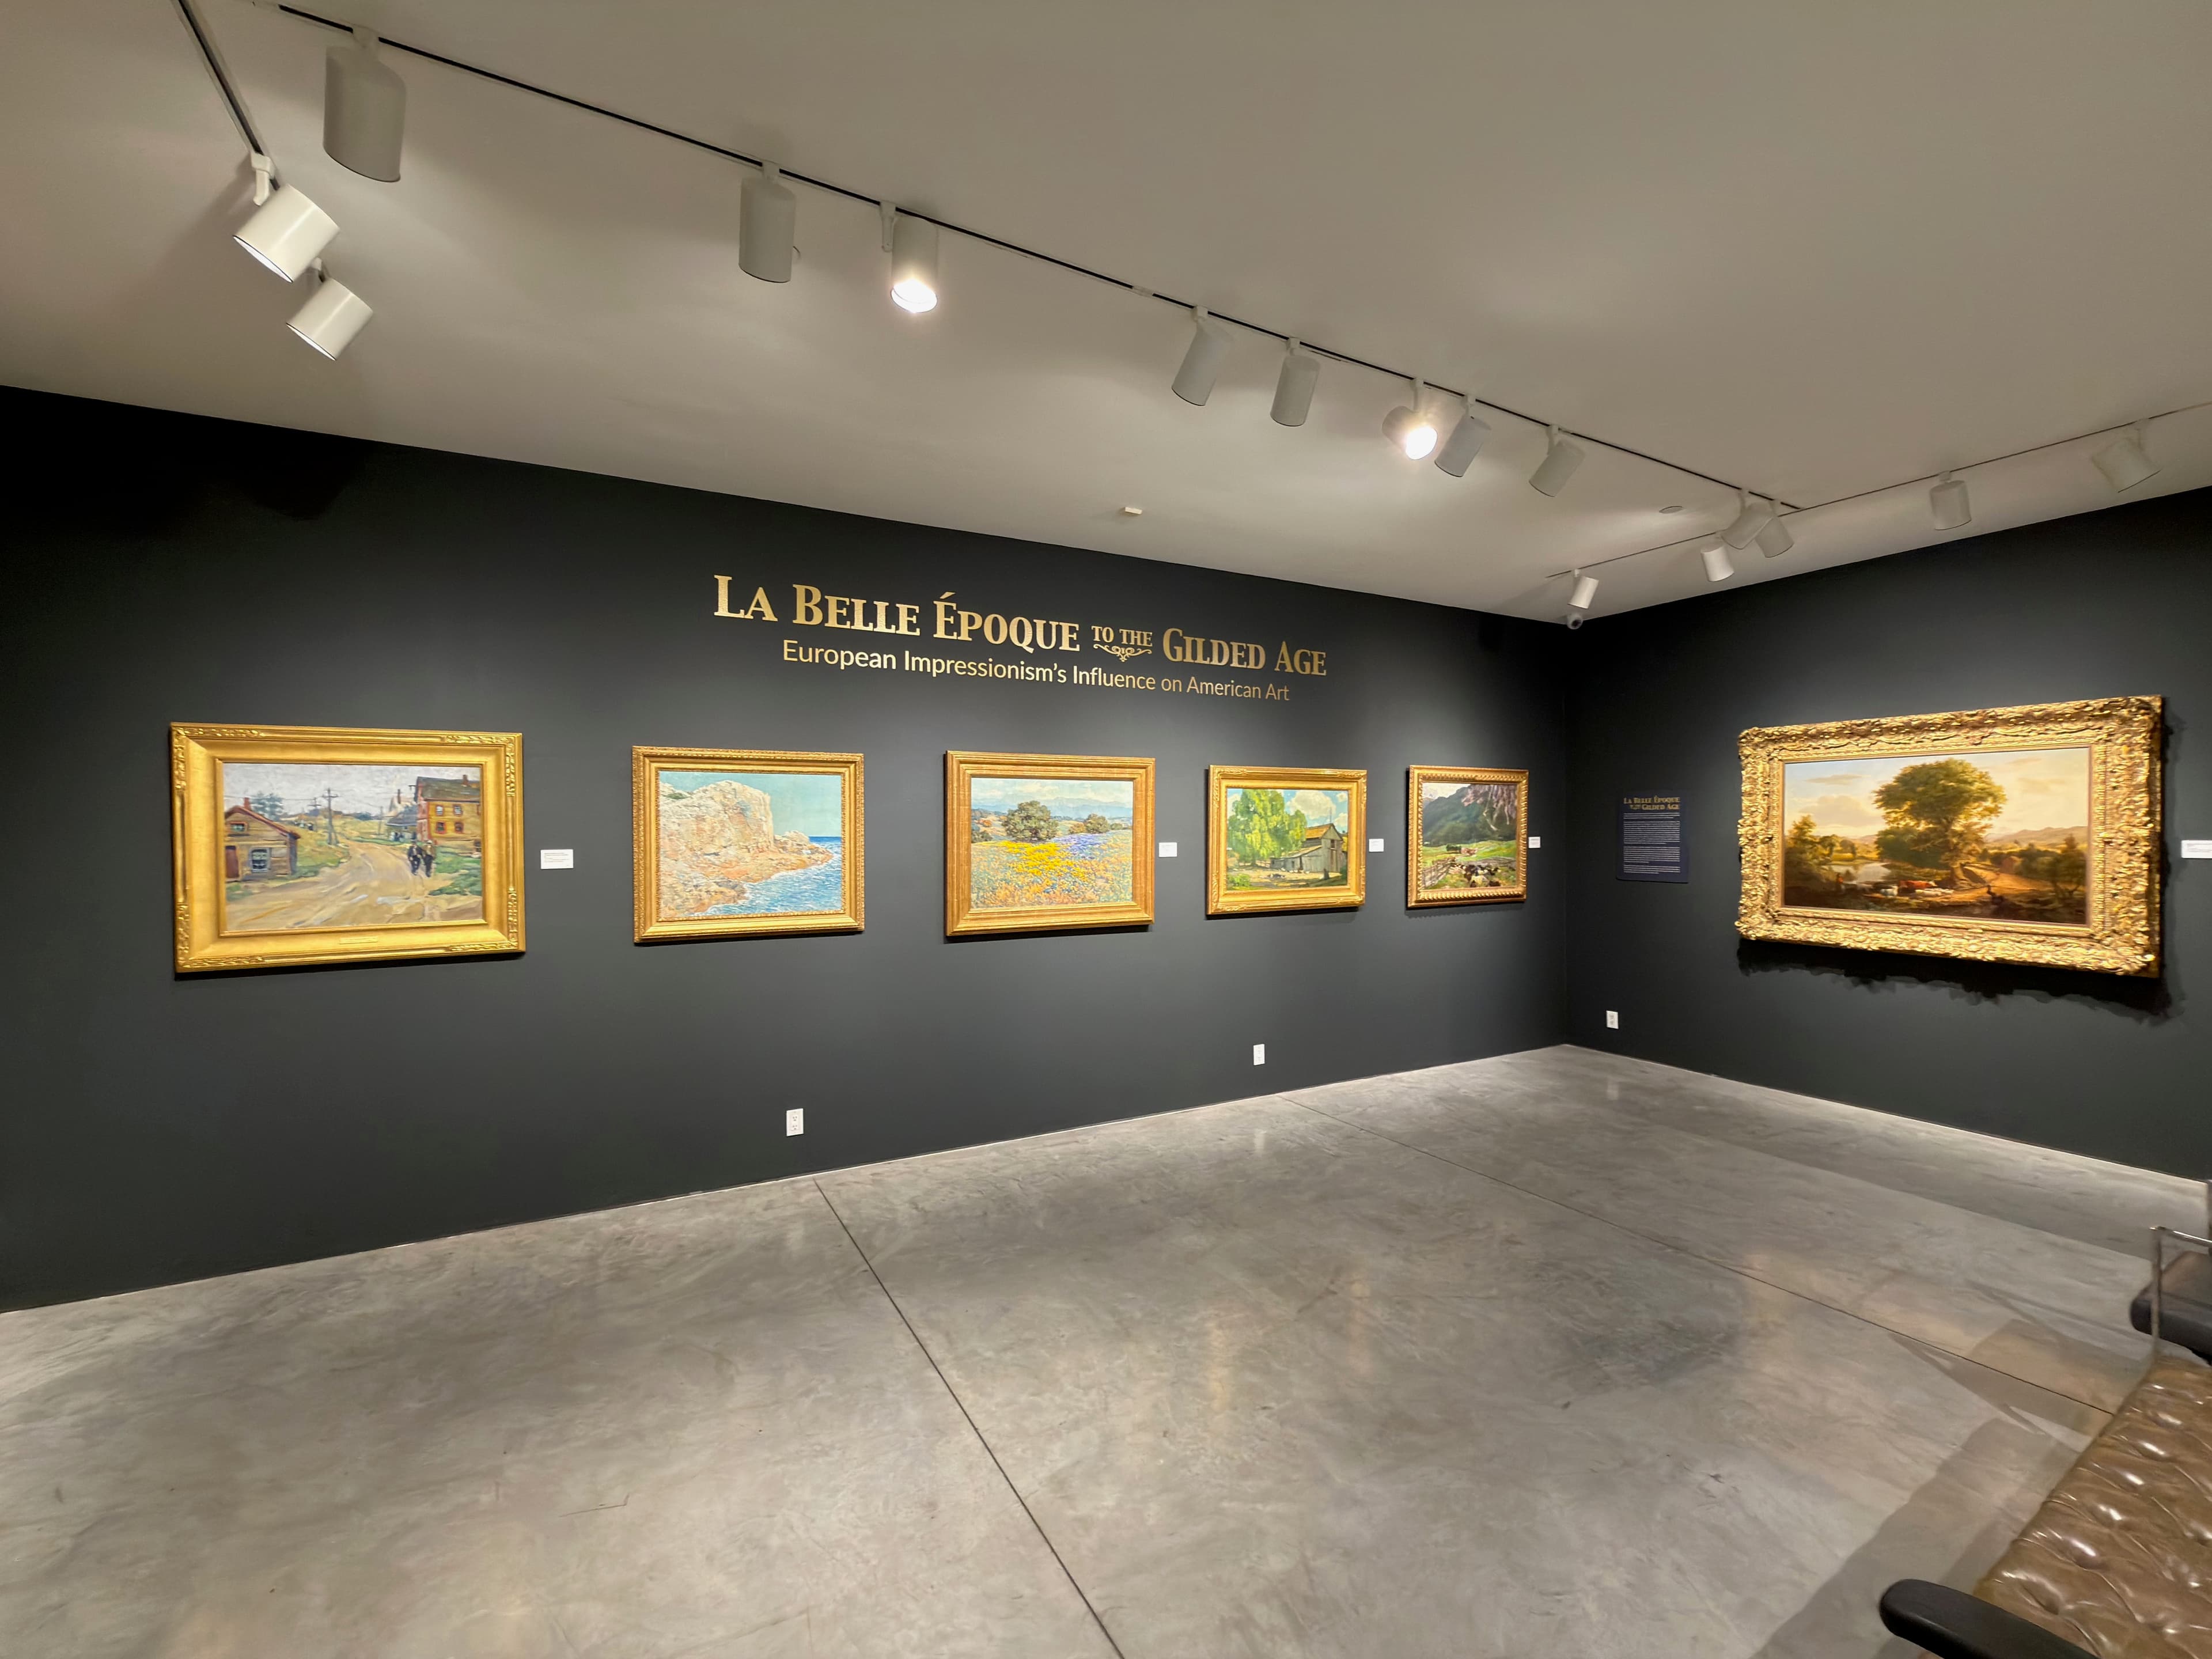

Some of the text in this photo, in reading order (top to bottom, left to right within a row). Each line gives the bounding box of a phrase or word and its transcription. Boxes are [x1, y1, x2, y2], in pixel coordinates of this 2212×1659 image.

[713, 574, 1327, 676] LA BELLE ÉPOQUE TO THE GILDED AGE
[783, 639, 896, 671] European
[1073, 665, 1156, 691] Influence
[1161, 678, 1182, 693] on
[1186, 676, 1261, 699] American
[1265, 683, 1290, 702] Art
